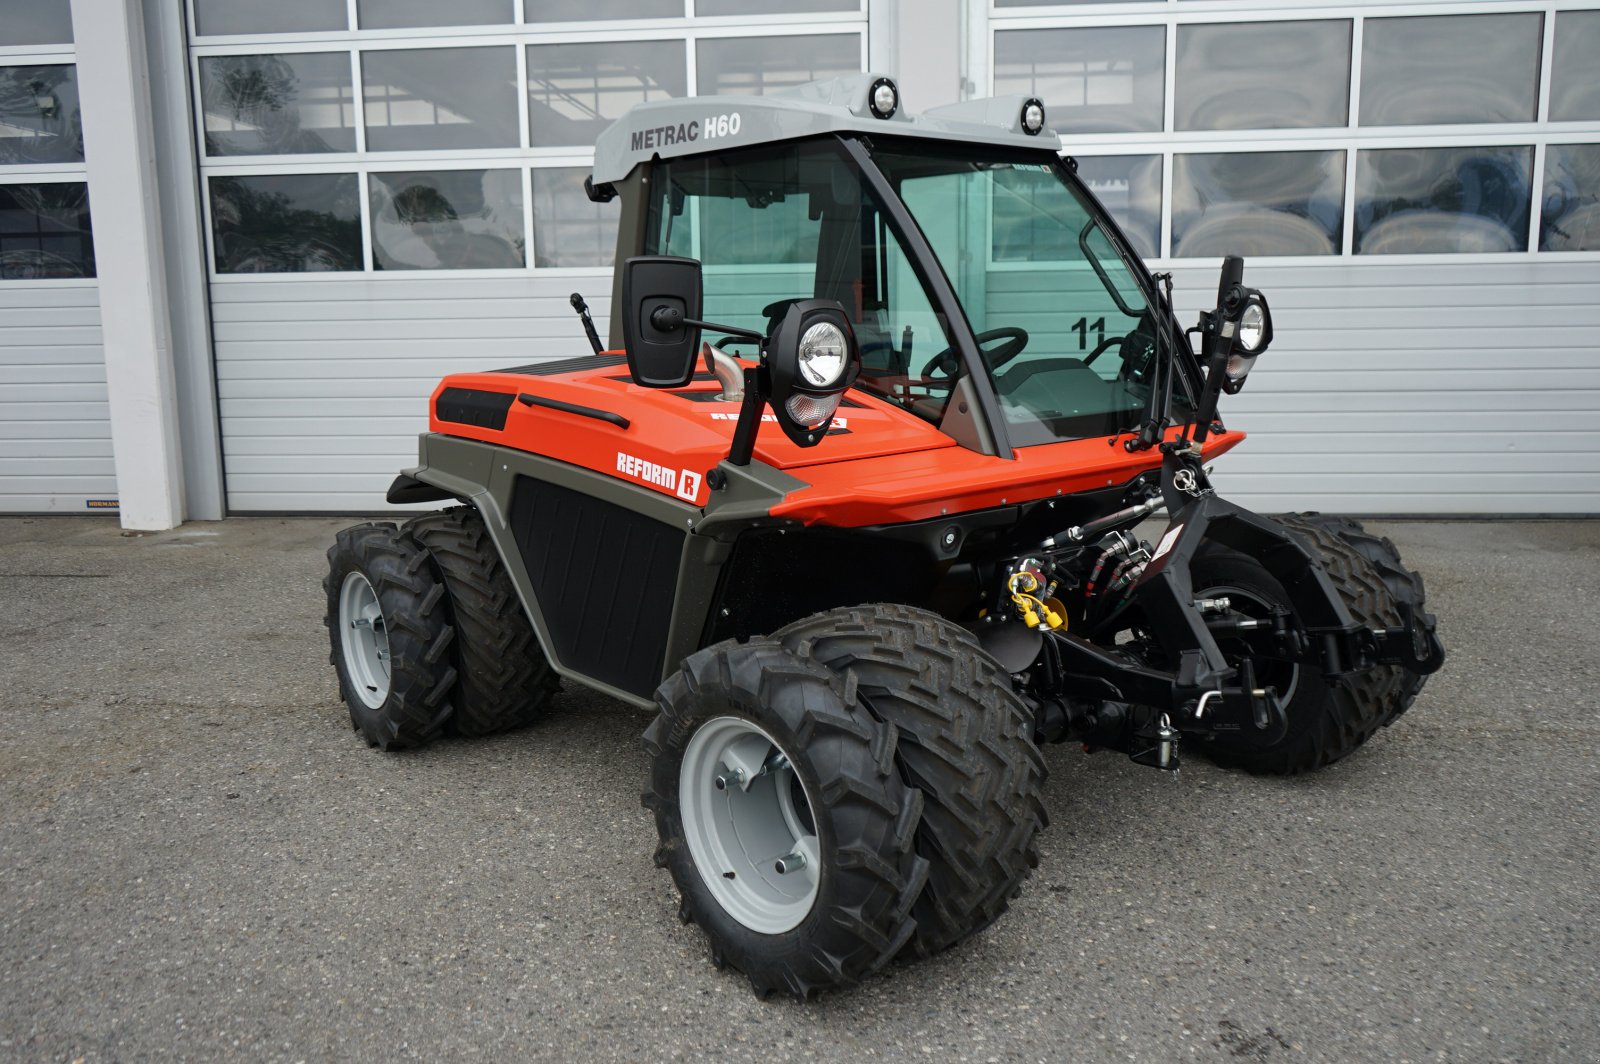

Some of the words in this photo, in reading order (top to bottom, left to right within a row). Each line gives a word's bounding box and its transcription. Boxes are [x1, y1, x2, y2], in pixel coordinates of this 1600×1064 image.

[631, 120, 699, 151] METRAC
[703, 112, 741, 139] H60
[1071, 317, 1105, 350] 11
[616, 452, 676, 490] REFORM
